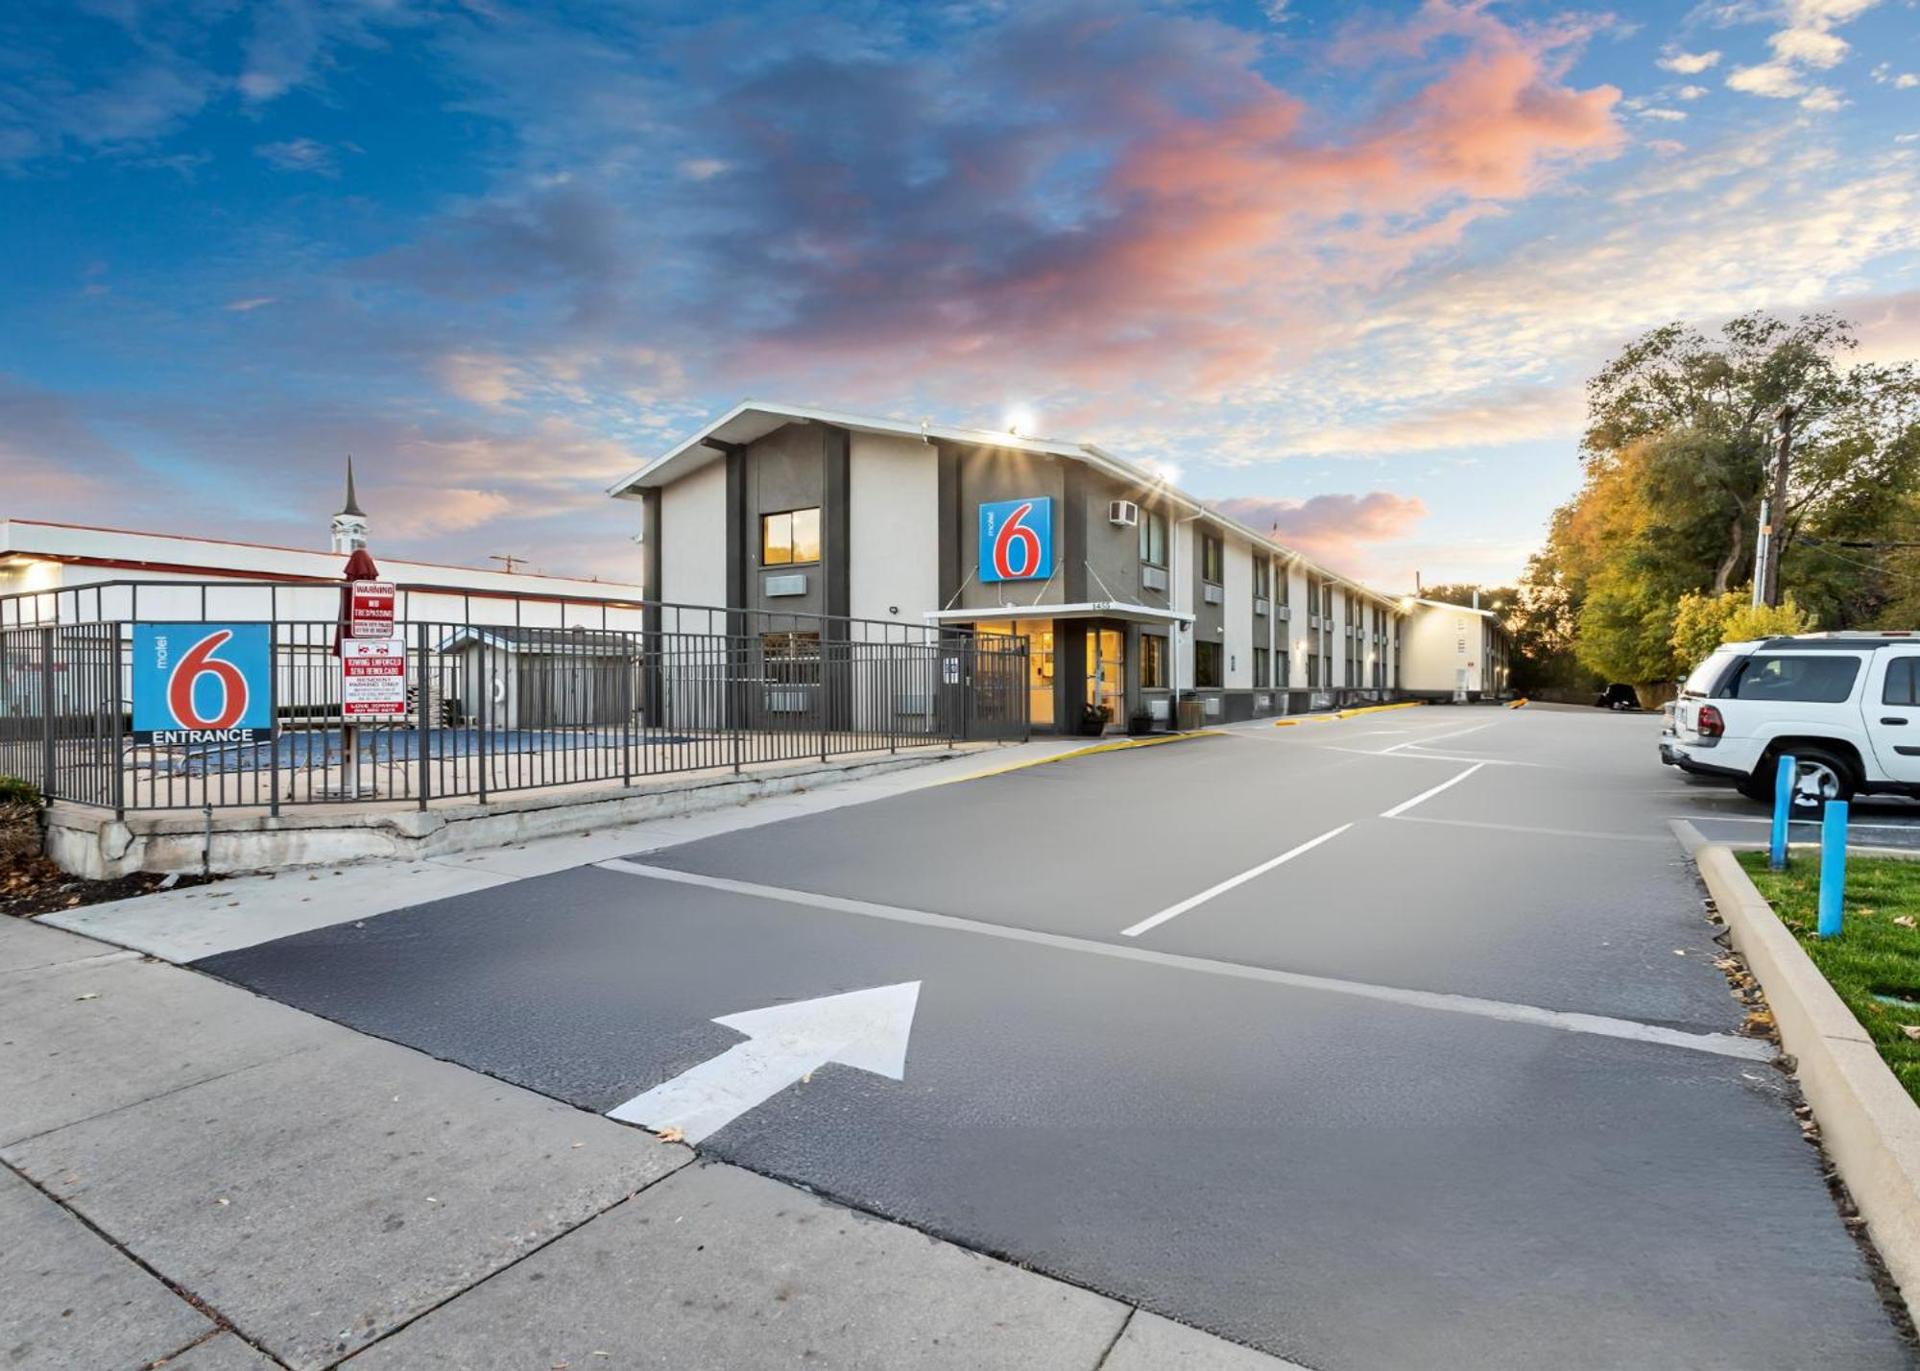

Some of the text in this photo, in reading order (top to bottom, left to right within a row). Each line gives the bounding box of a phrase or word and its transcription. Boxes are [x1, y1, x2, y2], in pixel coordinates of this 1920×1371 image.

[993, 502, 1042, 579] 6
[357, 586, 393, 595] WARNING
[368, 600, 380, 608] NO
[354, 608, 393, 618] TRESPASSING
[154, 629, 249, 730] motel 6
[153, 729, 253, 744] ENTRANCE
